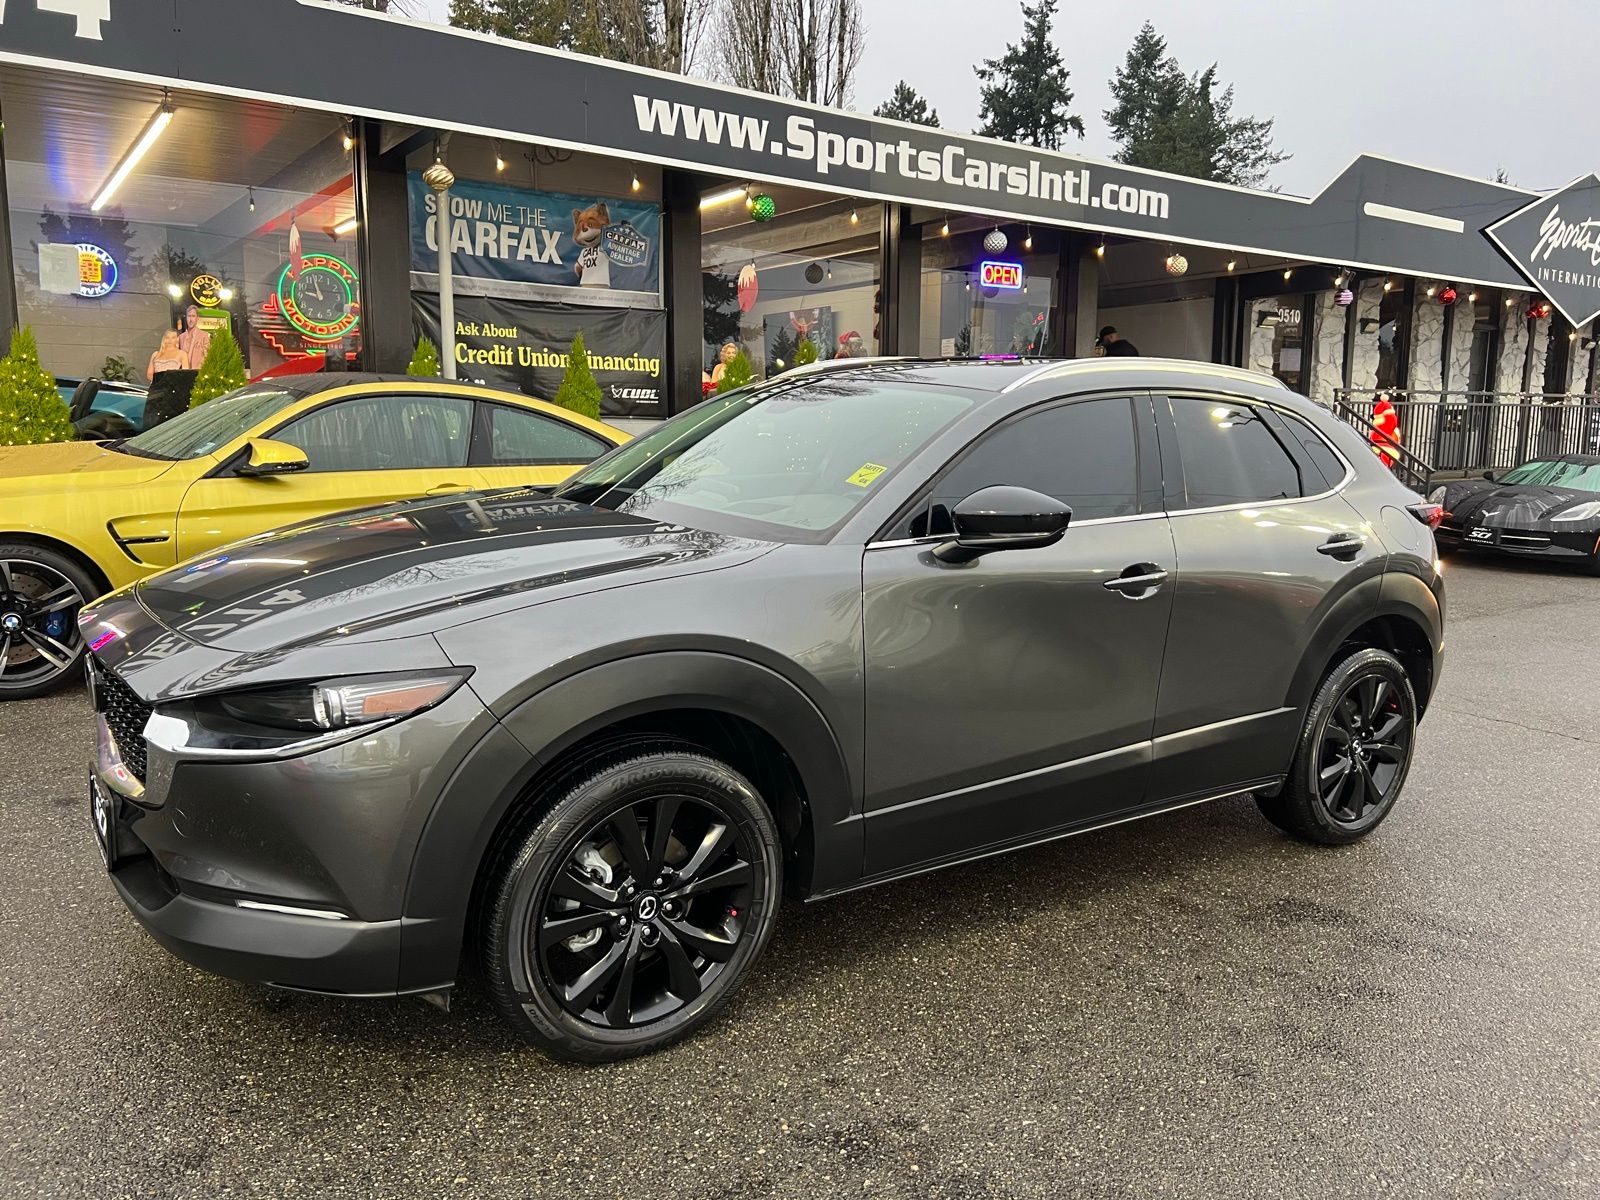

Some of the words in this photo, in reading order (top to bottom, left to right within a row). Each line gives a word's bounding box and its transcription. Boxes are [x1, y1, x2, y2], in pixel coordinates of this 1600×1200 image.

[633, 95, 1169, 219] www.SportsCarsIntl.com
[424, 194, 482, 218] SOW
[487, 202, 512, 223] ME
[516, 206, 546, 227] THE
[606, 231, 646, 251] CARFAX
[1530, 203, 1592, 262] Sports
[583, 246, 599, 258] CAR
[607, 241, 641, 259] ADVANTAGE
[609, 250, 634, 264] DEALER
[583, 257, 598, 269] FOX
[984, 265, 1020, 286] OPEN
[456, 321, 479, 336] Ask
[482, 323, 517, 339] About
[455, 343, 513, 366] Credit
[517, 346, 570, 368] Union
[584, 350, 660, 378] inancing
